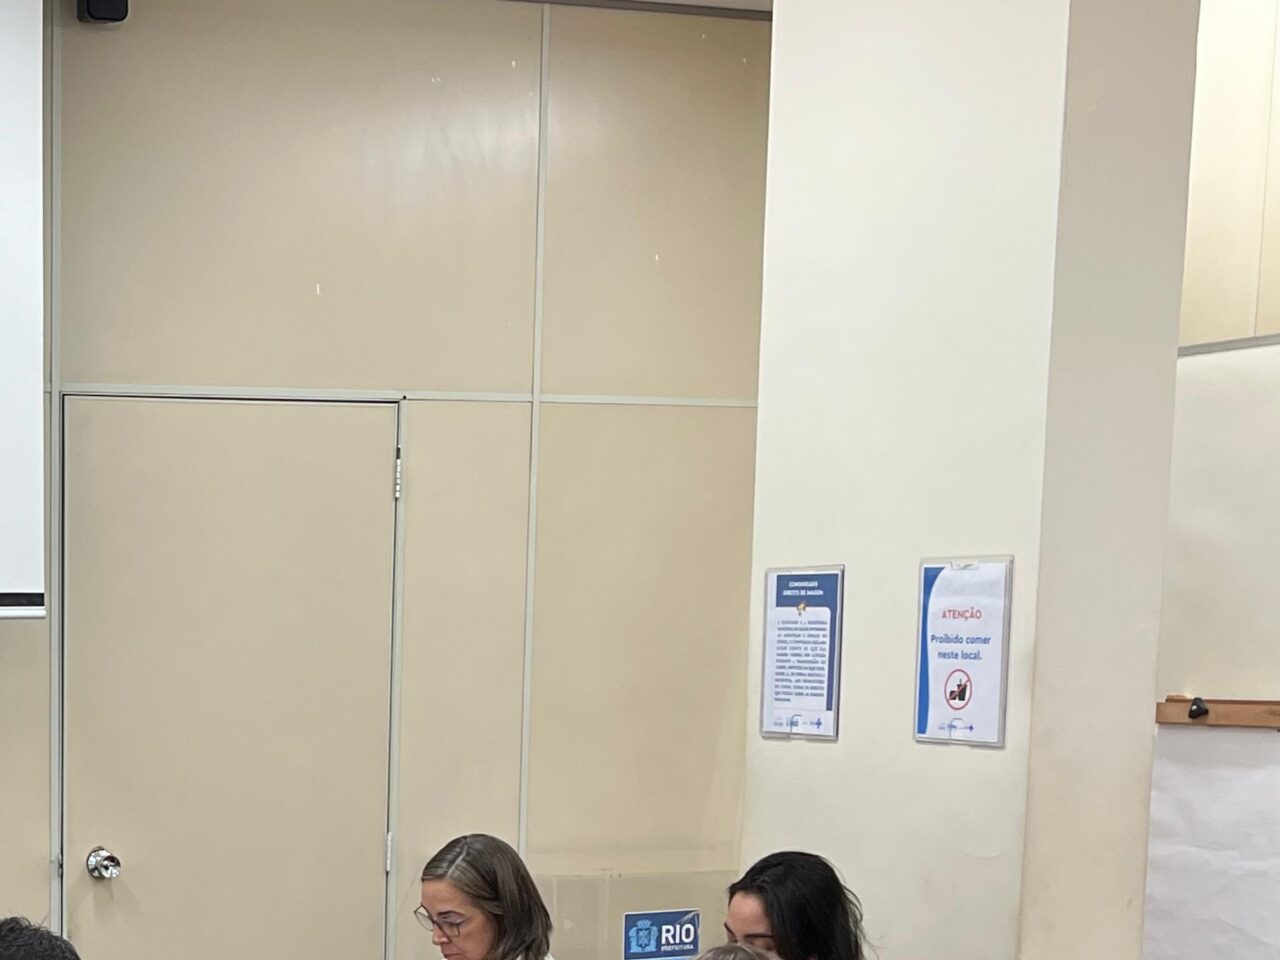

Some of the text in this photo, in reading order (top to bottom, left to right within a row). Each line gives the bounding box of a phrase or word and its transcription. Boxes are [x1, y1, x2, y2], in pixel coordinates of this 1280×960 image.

[941, 606, 983, 621] ATENÇÃO
[930, 633, 992, 645] Proibido comer
[937, 650, 983, 660] neste local.
[661, 923, 695, 945] RIO
